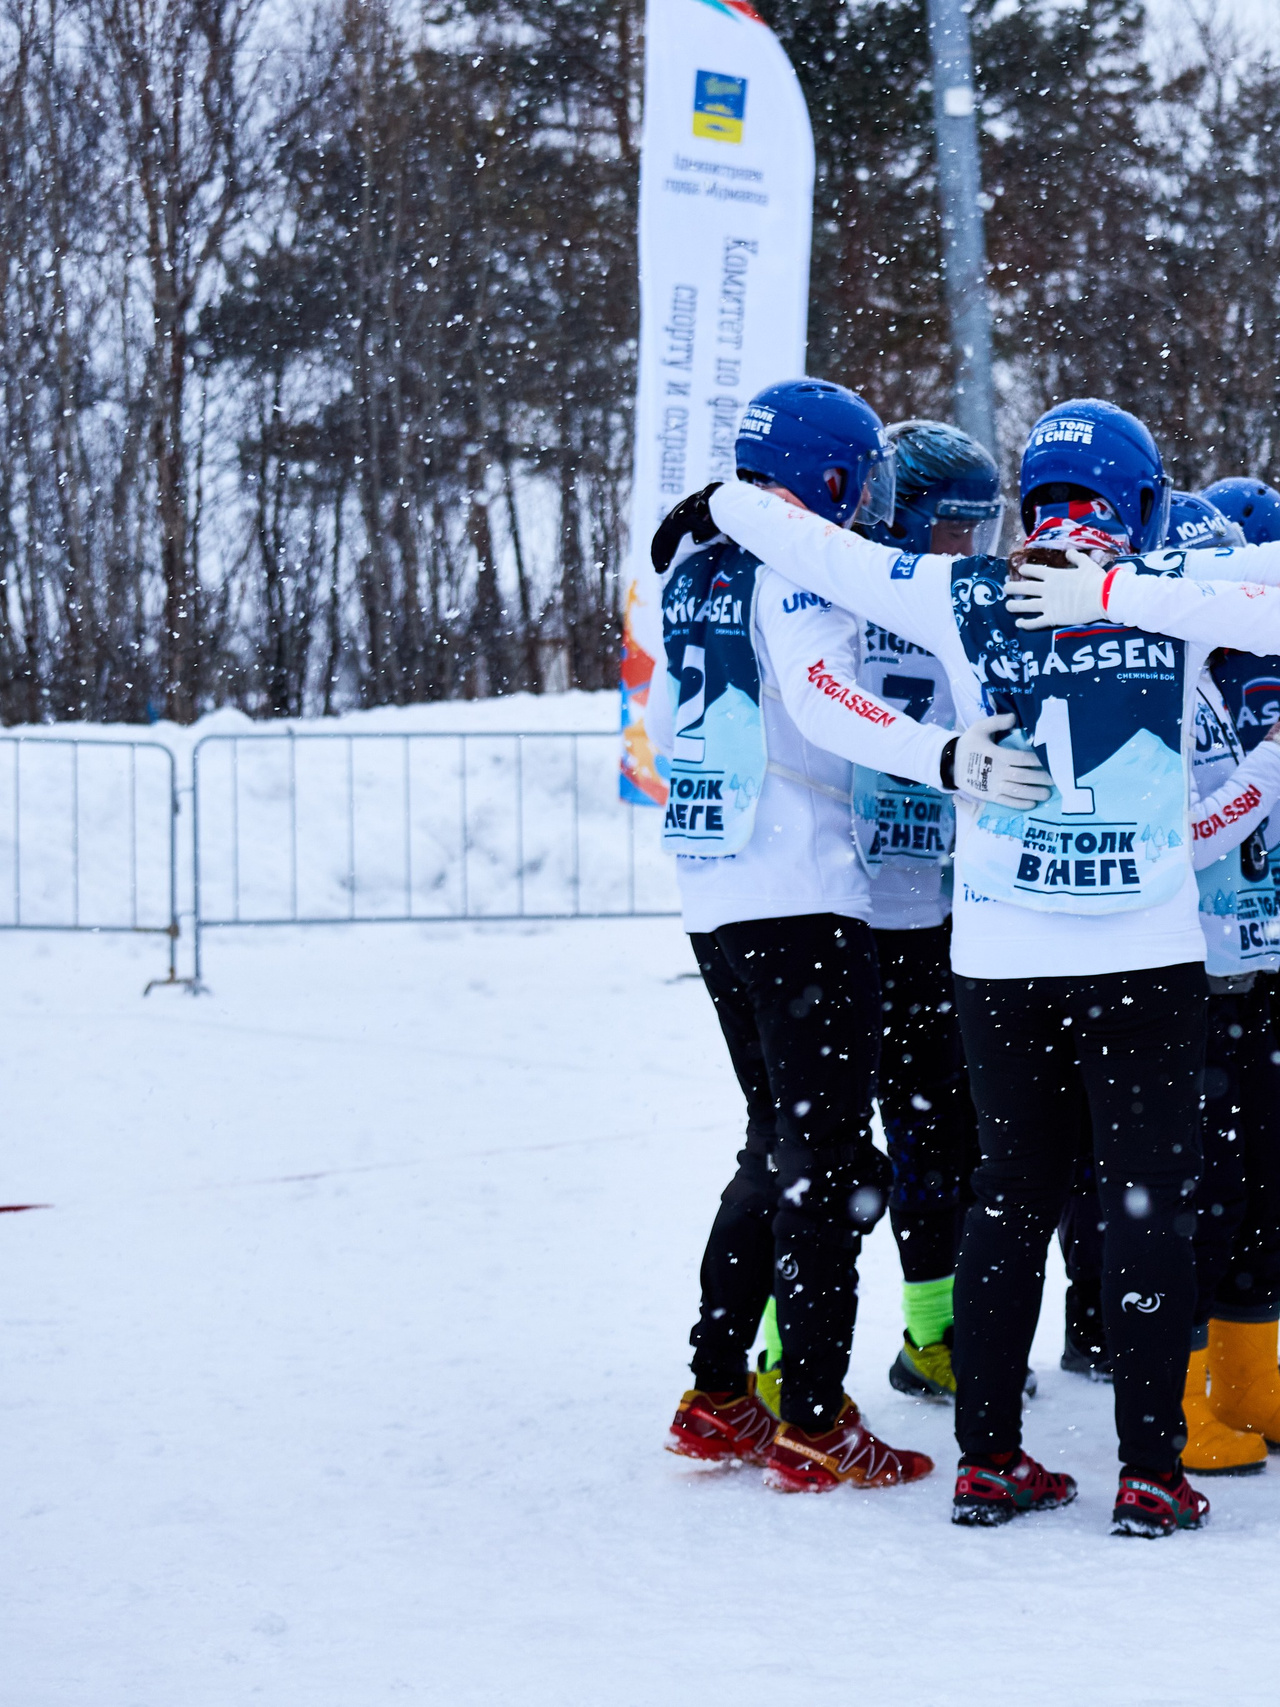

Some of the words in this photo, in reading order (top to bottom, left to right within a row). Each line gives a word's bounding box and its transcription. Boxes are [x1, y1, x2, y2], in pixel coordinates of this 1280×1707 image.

[717, 236, 758, 350] Комитет
[662, 284, 698, 373] спорту
[715, 357, 741, 387] по
[1045, 430, 1093, 445] СНЕГЕ
[1060, 421, 1094, 433] ТОЛК
[1116, 672, 1158, 681] СНЕЖНЫЙ
[1160, 673, 1175, 682] БОЙ
[672, 644, 706, 764] 2
[1033, 697, 1095, 815] 1
[1023, 840, 1046, 852] КТО
[1025, 827, 1055, 842] ДЛЯ
[1060, 832, 1137, 855] ТОЛК
[1016, 852, 1042, 883] В
